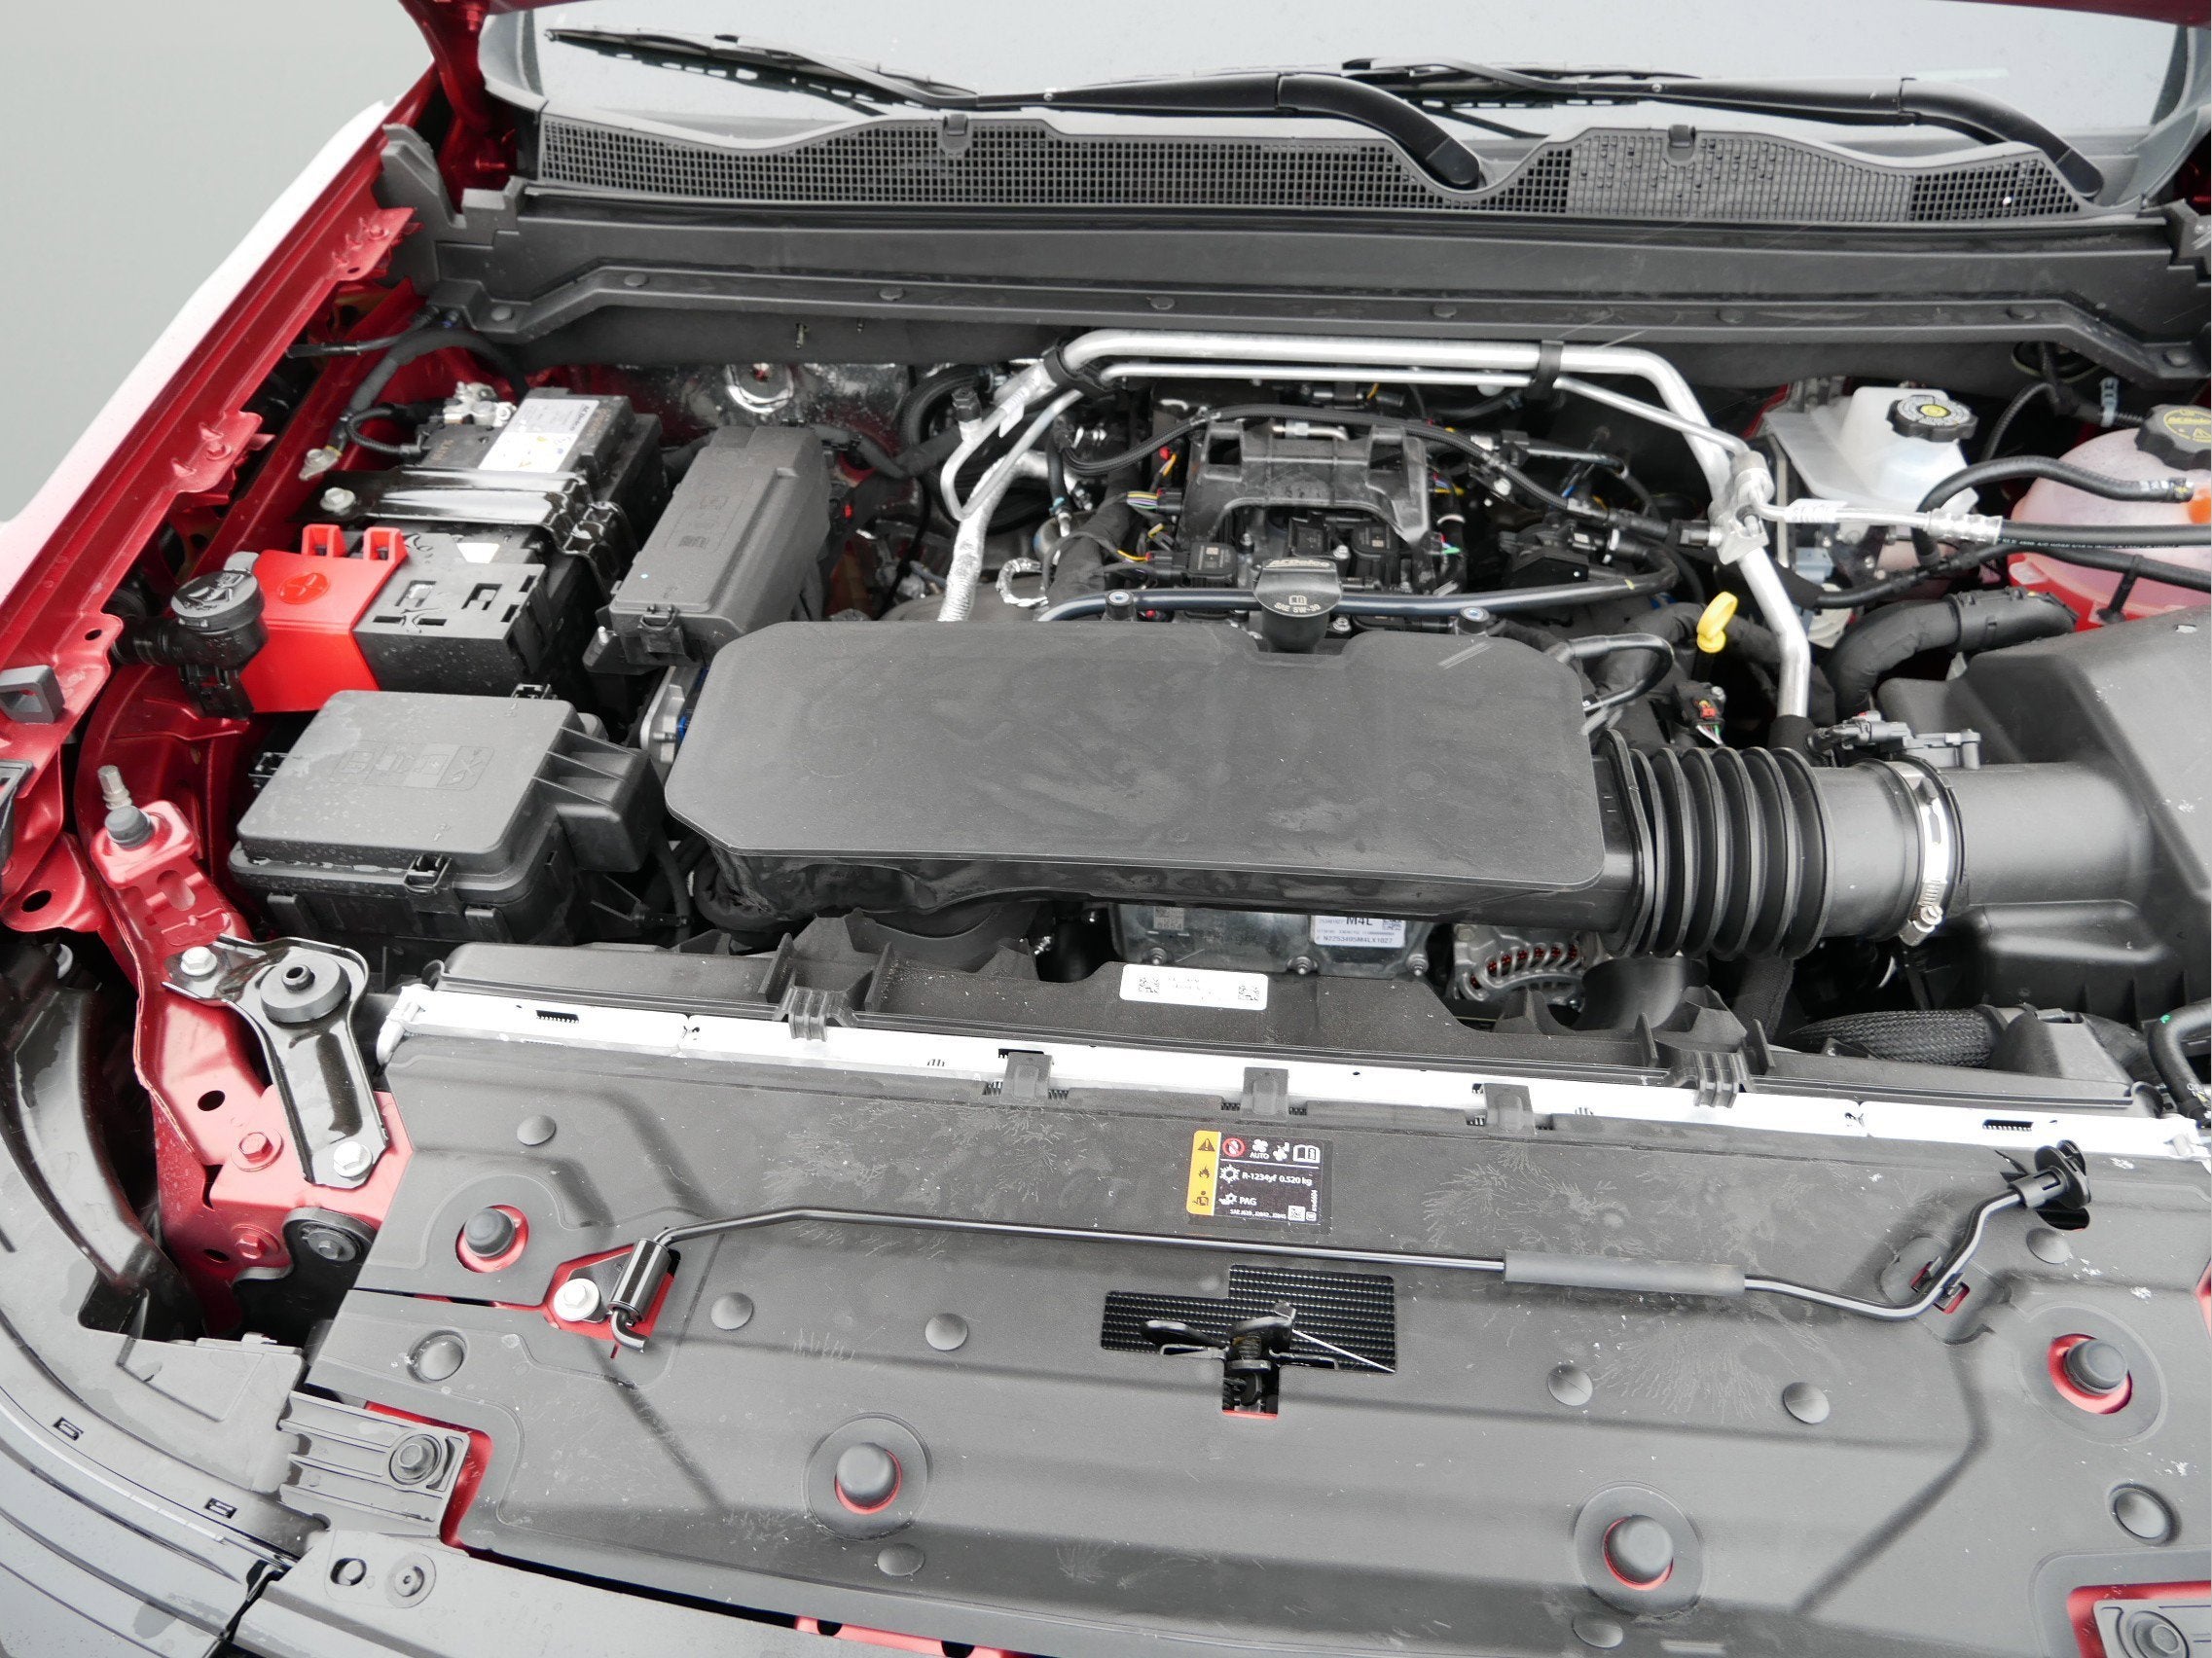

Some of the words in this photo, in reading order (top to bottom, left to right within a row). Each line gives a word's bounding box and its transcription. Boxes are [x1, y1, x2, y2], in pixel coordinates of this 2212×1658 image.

[1265, 559, 1330, 568] ACDelco
[1274, 602, 1290, 612] SAE
[1242, 1171, 1278, 1183] R-1234yf
[1279, 1173, 1301, 1184] 0.520
[1301, 1175, 1313, 1187] kg
[1239, 1197, 1257, 1206] PAG
